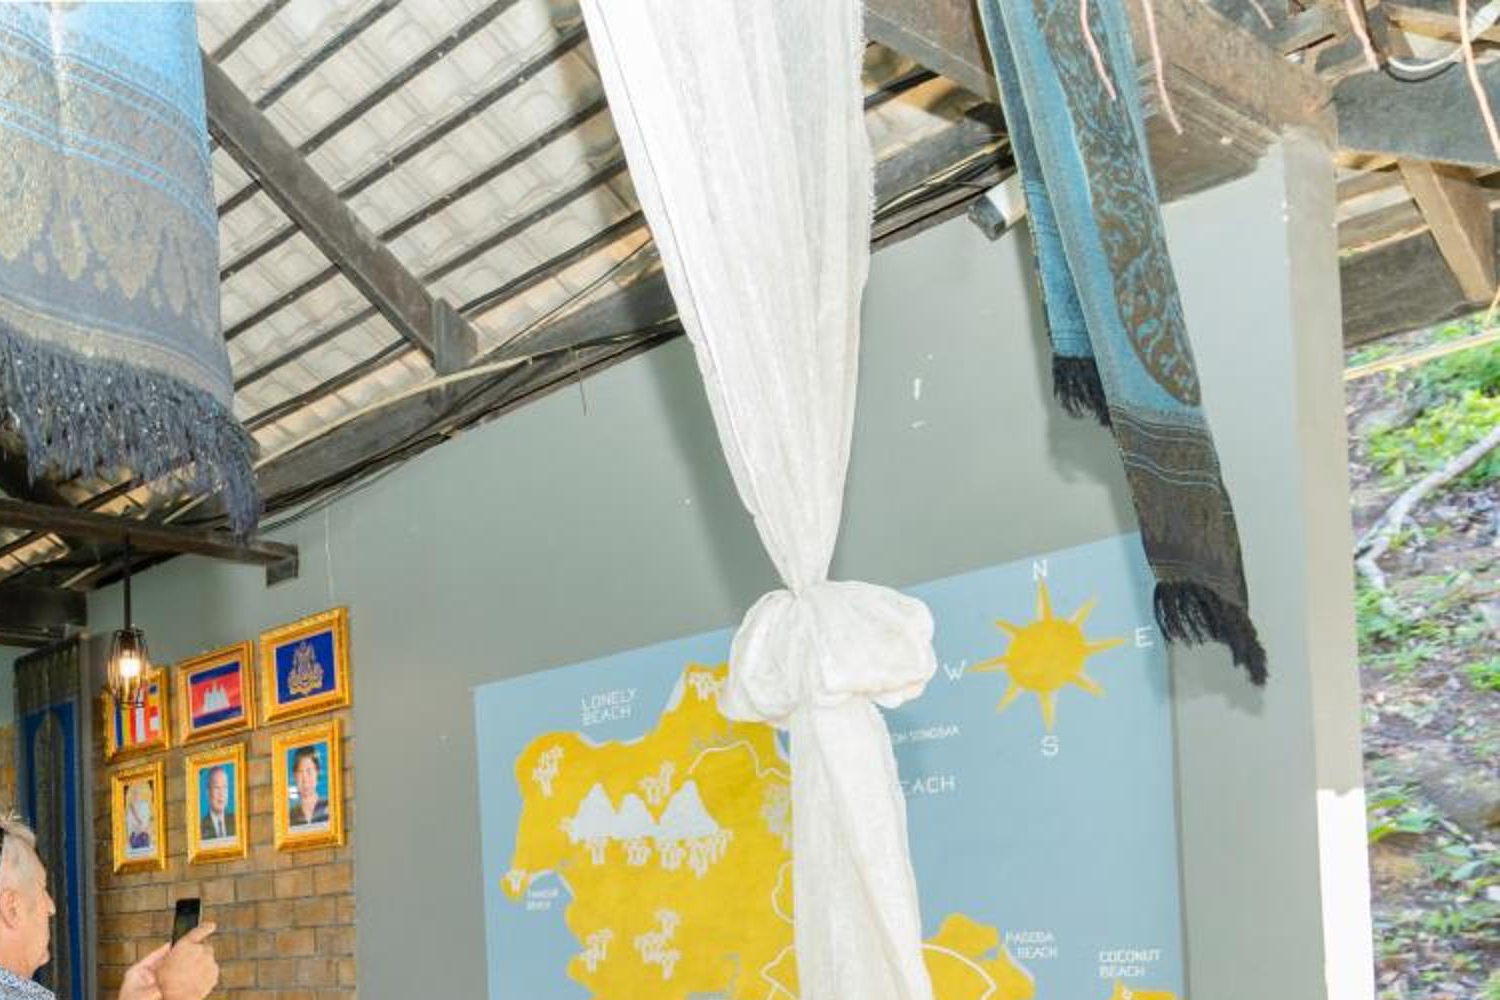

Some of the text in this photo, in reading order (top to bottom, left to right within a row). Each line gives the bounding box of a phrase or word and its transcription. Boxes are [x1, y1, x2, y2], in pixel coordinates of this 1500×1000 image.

[1033, 560, 1048, 581] N
[1135, 626, 1154, 648] E
[943, 659, 966, 681] W
[581, 687, 637, 710] LONELY
[582, 703, 631, 726] BEACH
[1040, 735, 1060, 757] S
[899, 775, 956, 797] EACH
[1015, 945, 1059, 961] BEACH
[1099, 948, 1162, 964] COCONUT
[1099, 964, 1147, 978] BEACH
